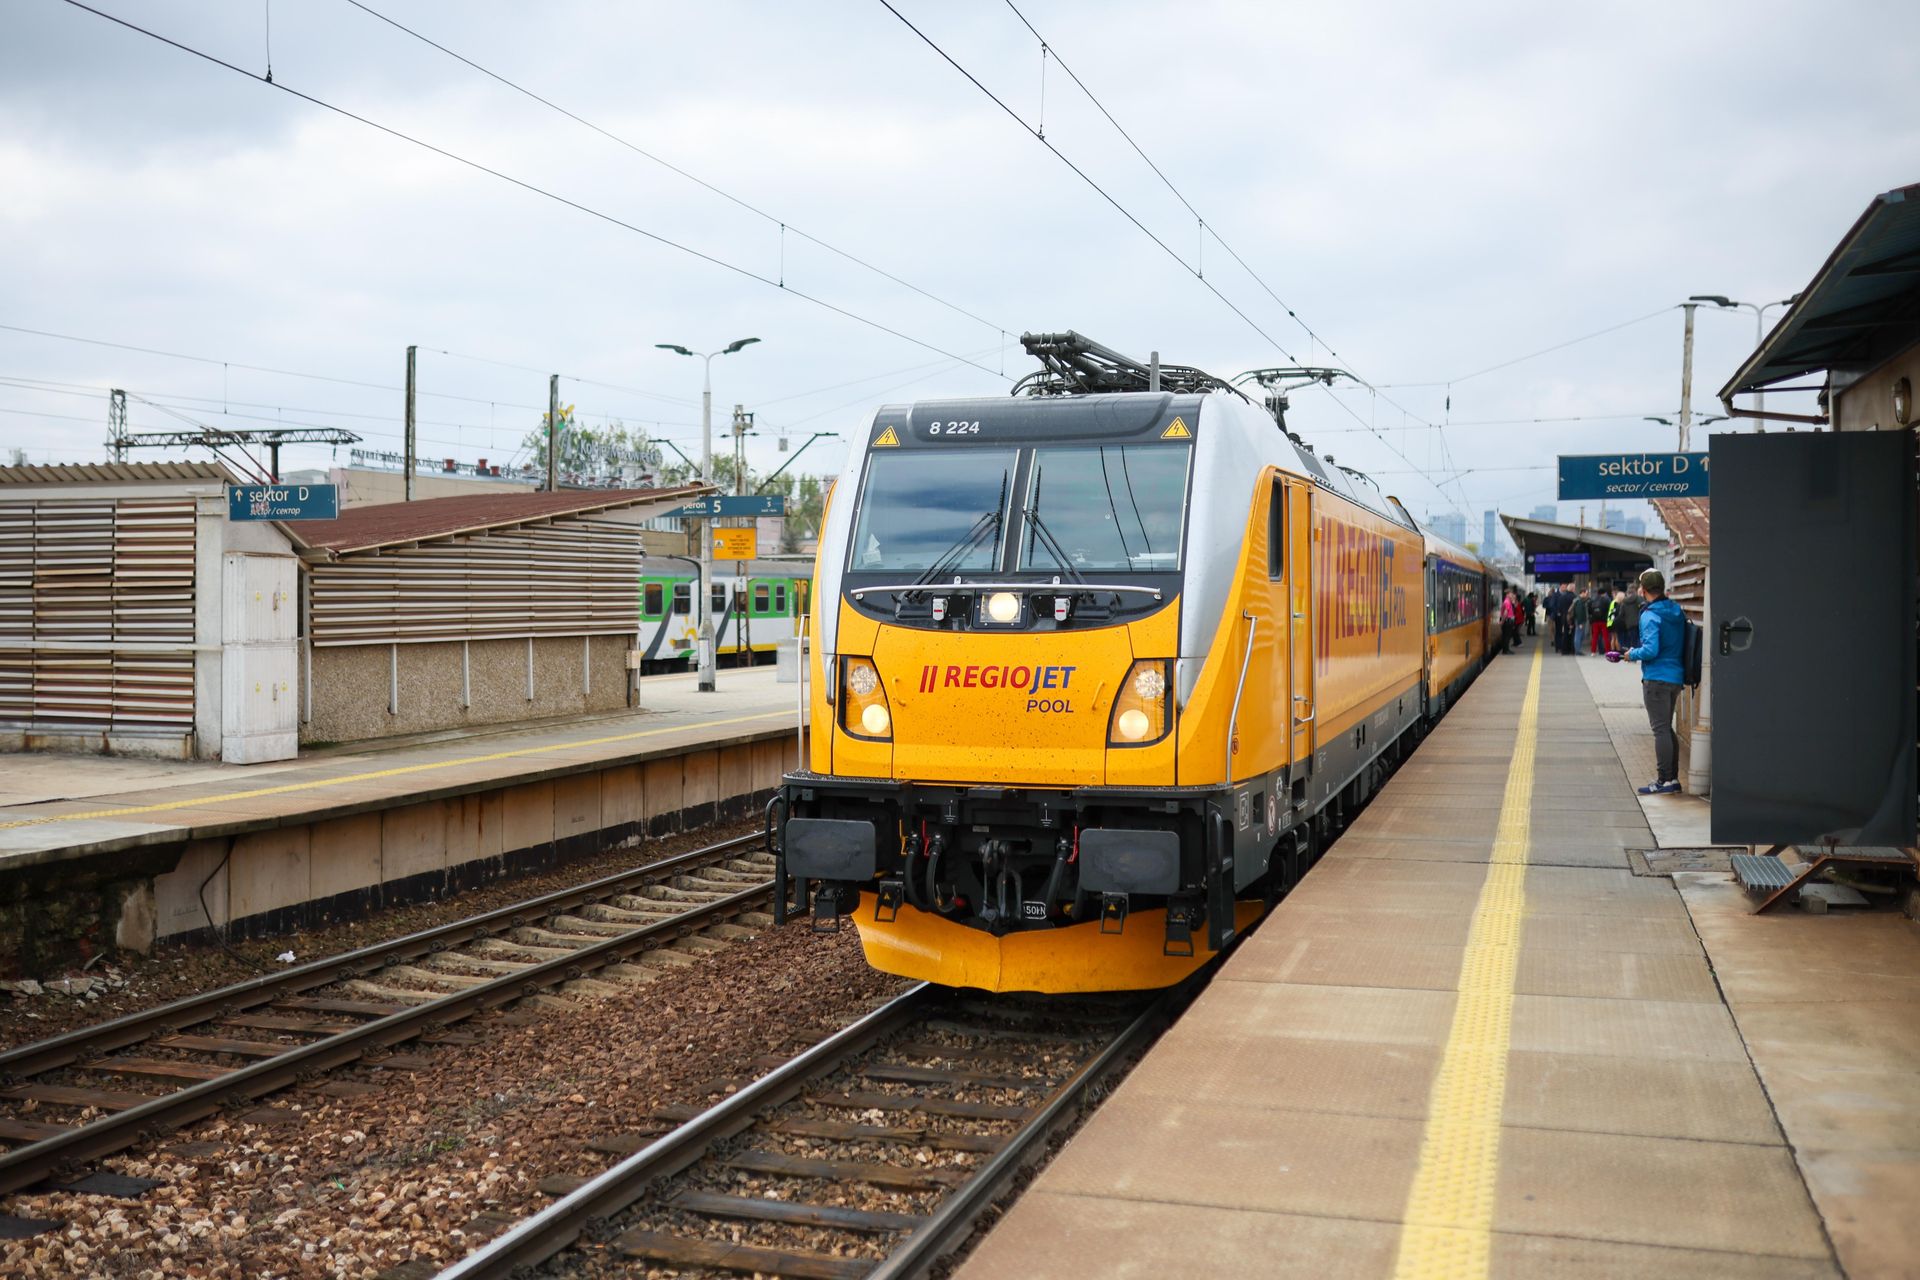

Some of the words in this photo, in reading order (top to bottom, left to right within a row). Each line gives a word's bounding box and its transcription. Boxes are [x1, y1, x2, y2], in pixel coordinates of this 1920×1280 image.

[929, 421, 941, 434] 8
[946, 421, 980, 434] 224
[1599, 456, 1664, 476] sektor
[1673, 455, 1689, 474] D
[249, 487, 289, 502] sektor
[299, 486, 309, 501] D
[1606, 482, 1640, 493] sector
[1649, 482, 1689, 493] сектор
[713, 500, 722, 513] 5
[1336, 521, 1395, 659] REGIOJET
[944, 665, 1077, 695] REGIOJET
[1026, 699, 1074, 713] POOL
